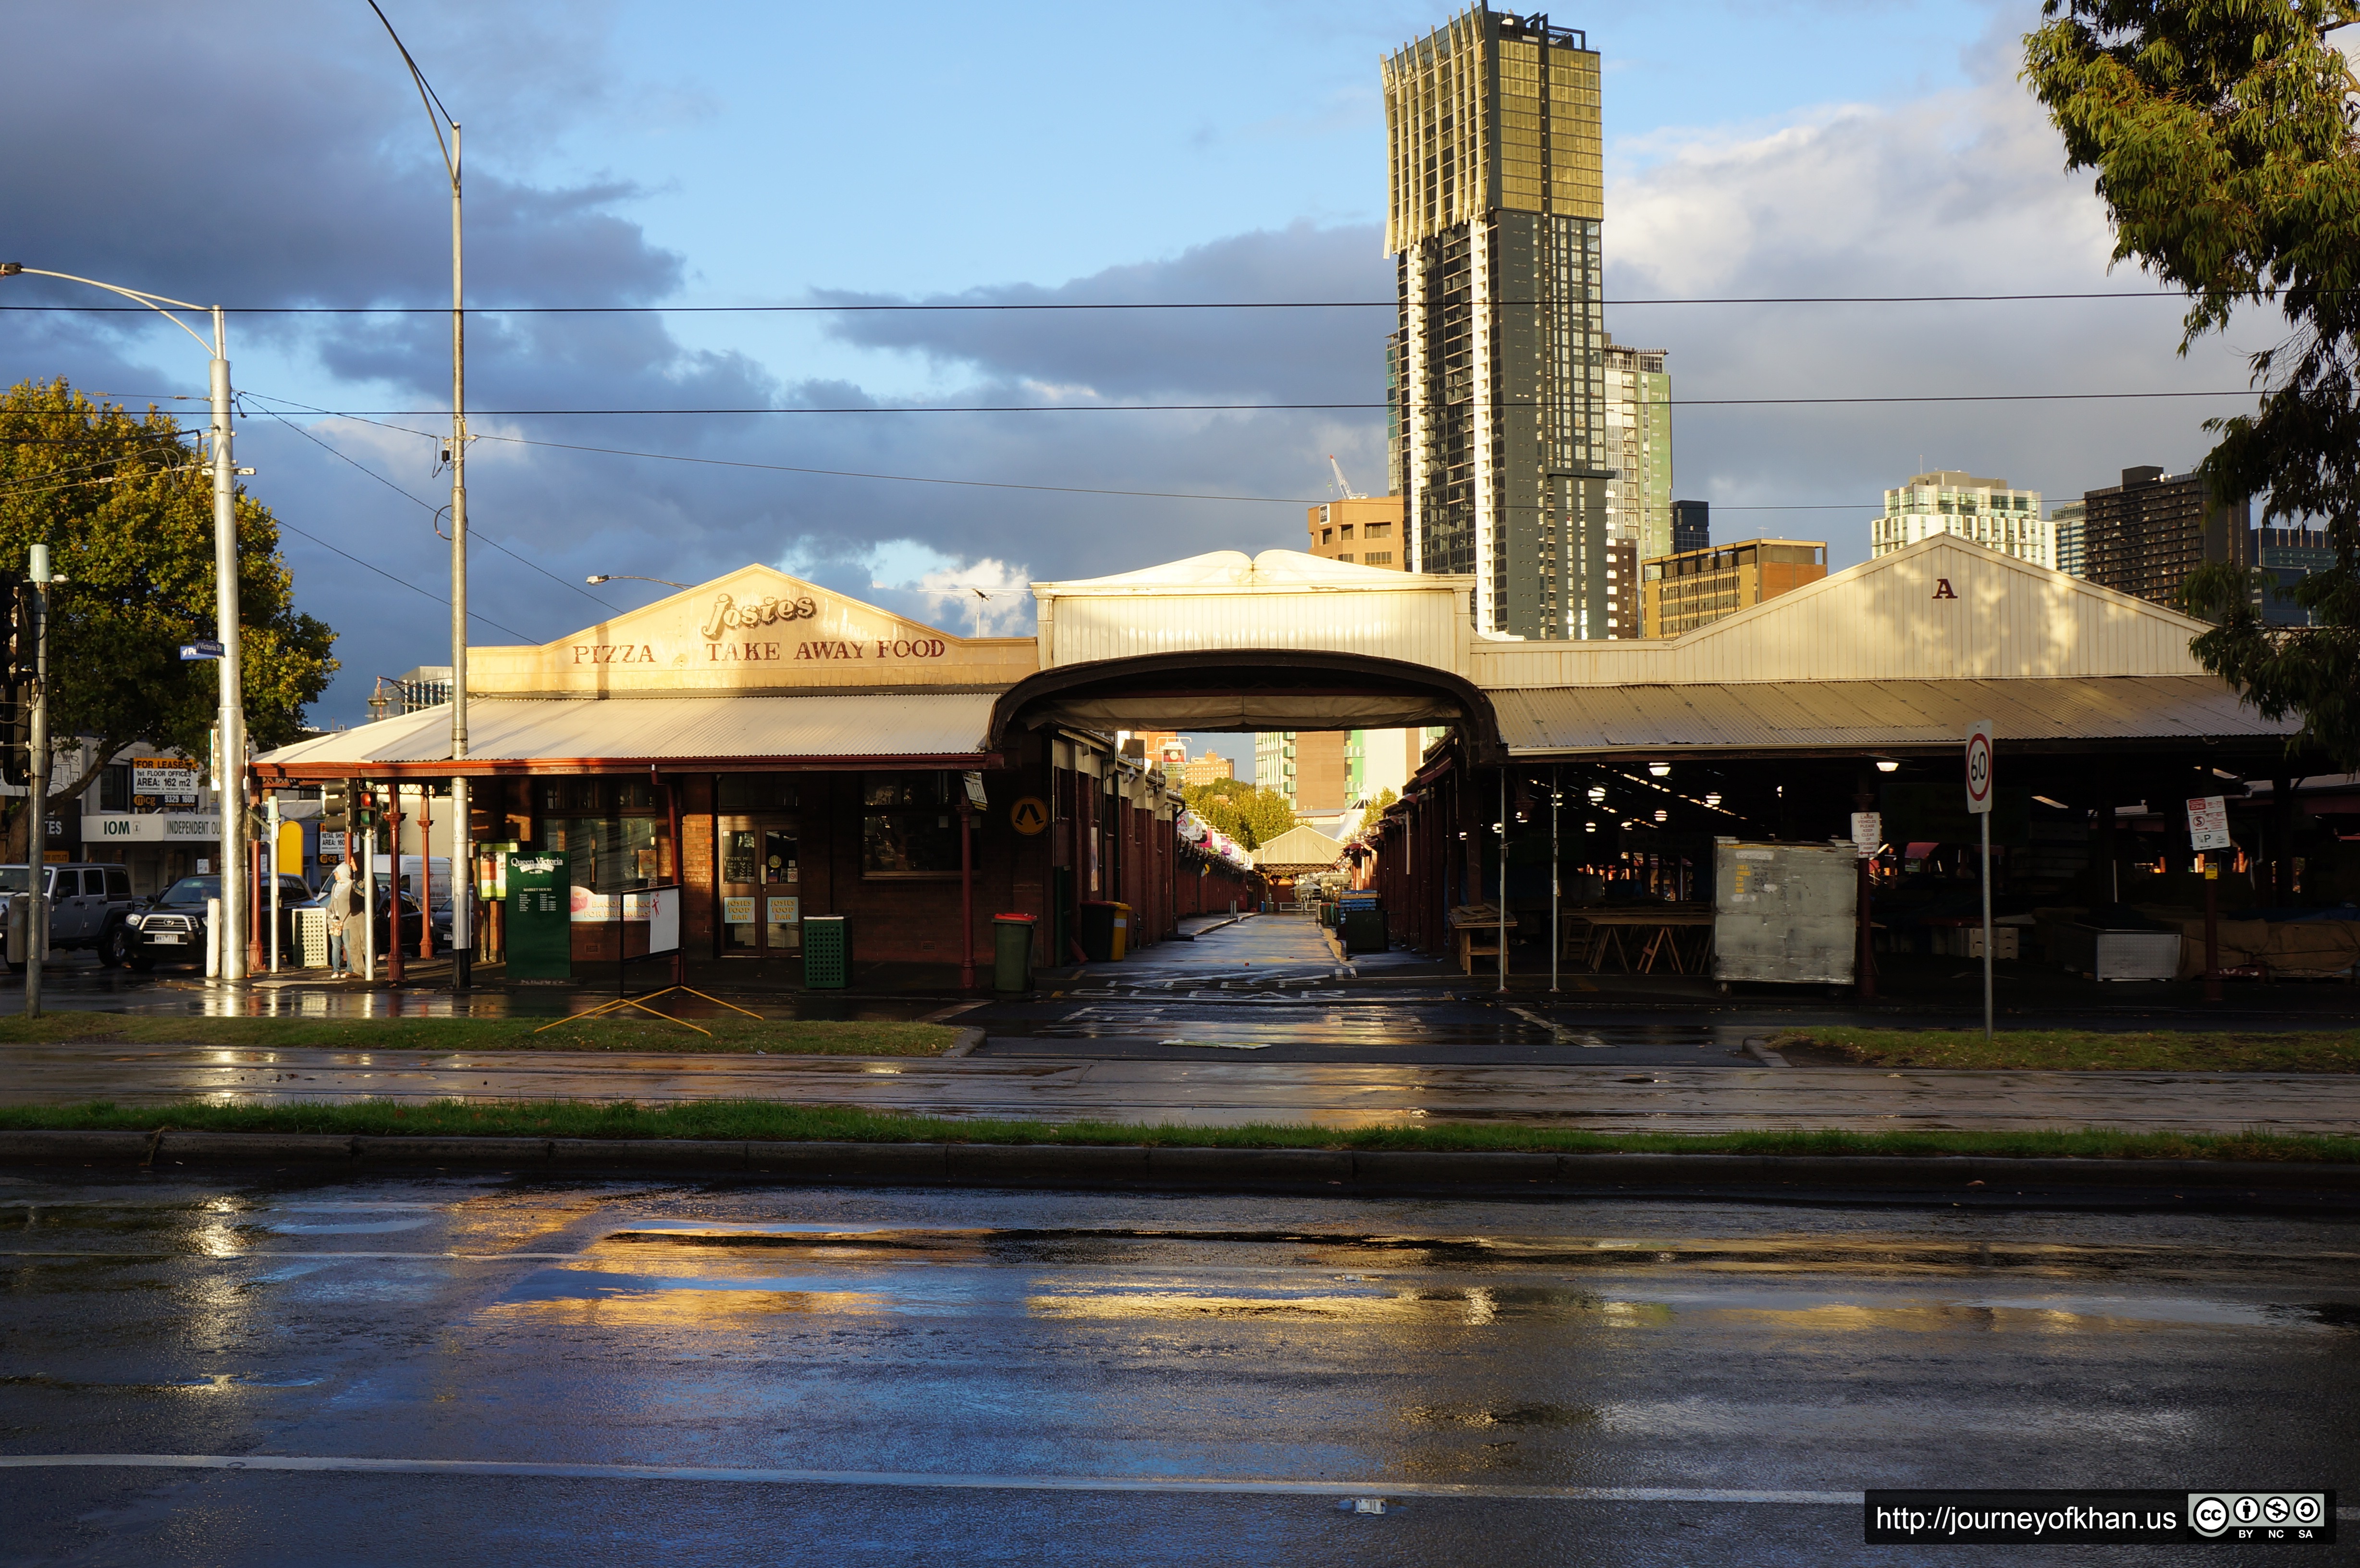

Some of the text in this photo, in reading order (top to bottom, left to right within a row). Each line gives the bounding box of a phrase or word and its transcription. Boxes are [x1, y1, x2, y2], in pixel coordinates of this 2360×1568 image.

[1931, 578, 1958, 599] A
[199, 643, 216, 651] Victoria
[706, 639, 946, 661] TAKE AWAY FOOD
[573, 645, 656, 664] PIZZA
[1971, 751, 1987, 782] 60
[137, 778, 191, 787] AREA: 162 m2
[134, 796, 156, 806] mcg
[165, 795, 179, 803] 9329
[104, 821, 221, 835] IOM INDEPENDENT OU
[510, 857, 563, 867] Queen Victoria
[604, 910, 651, 918] BREAKFAS
[1069, 988, 1348, 999] CLEAR
